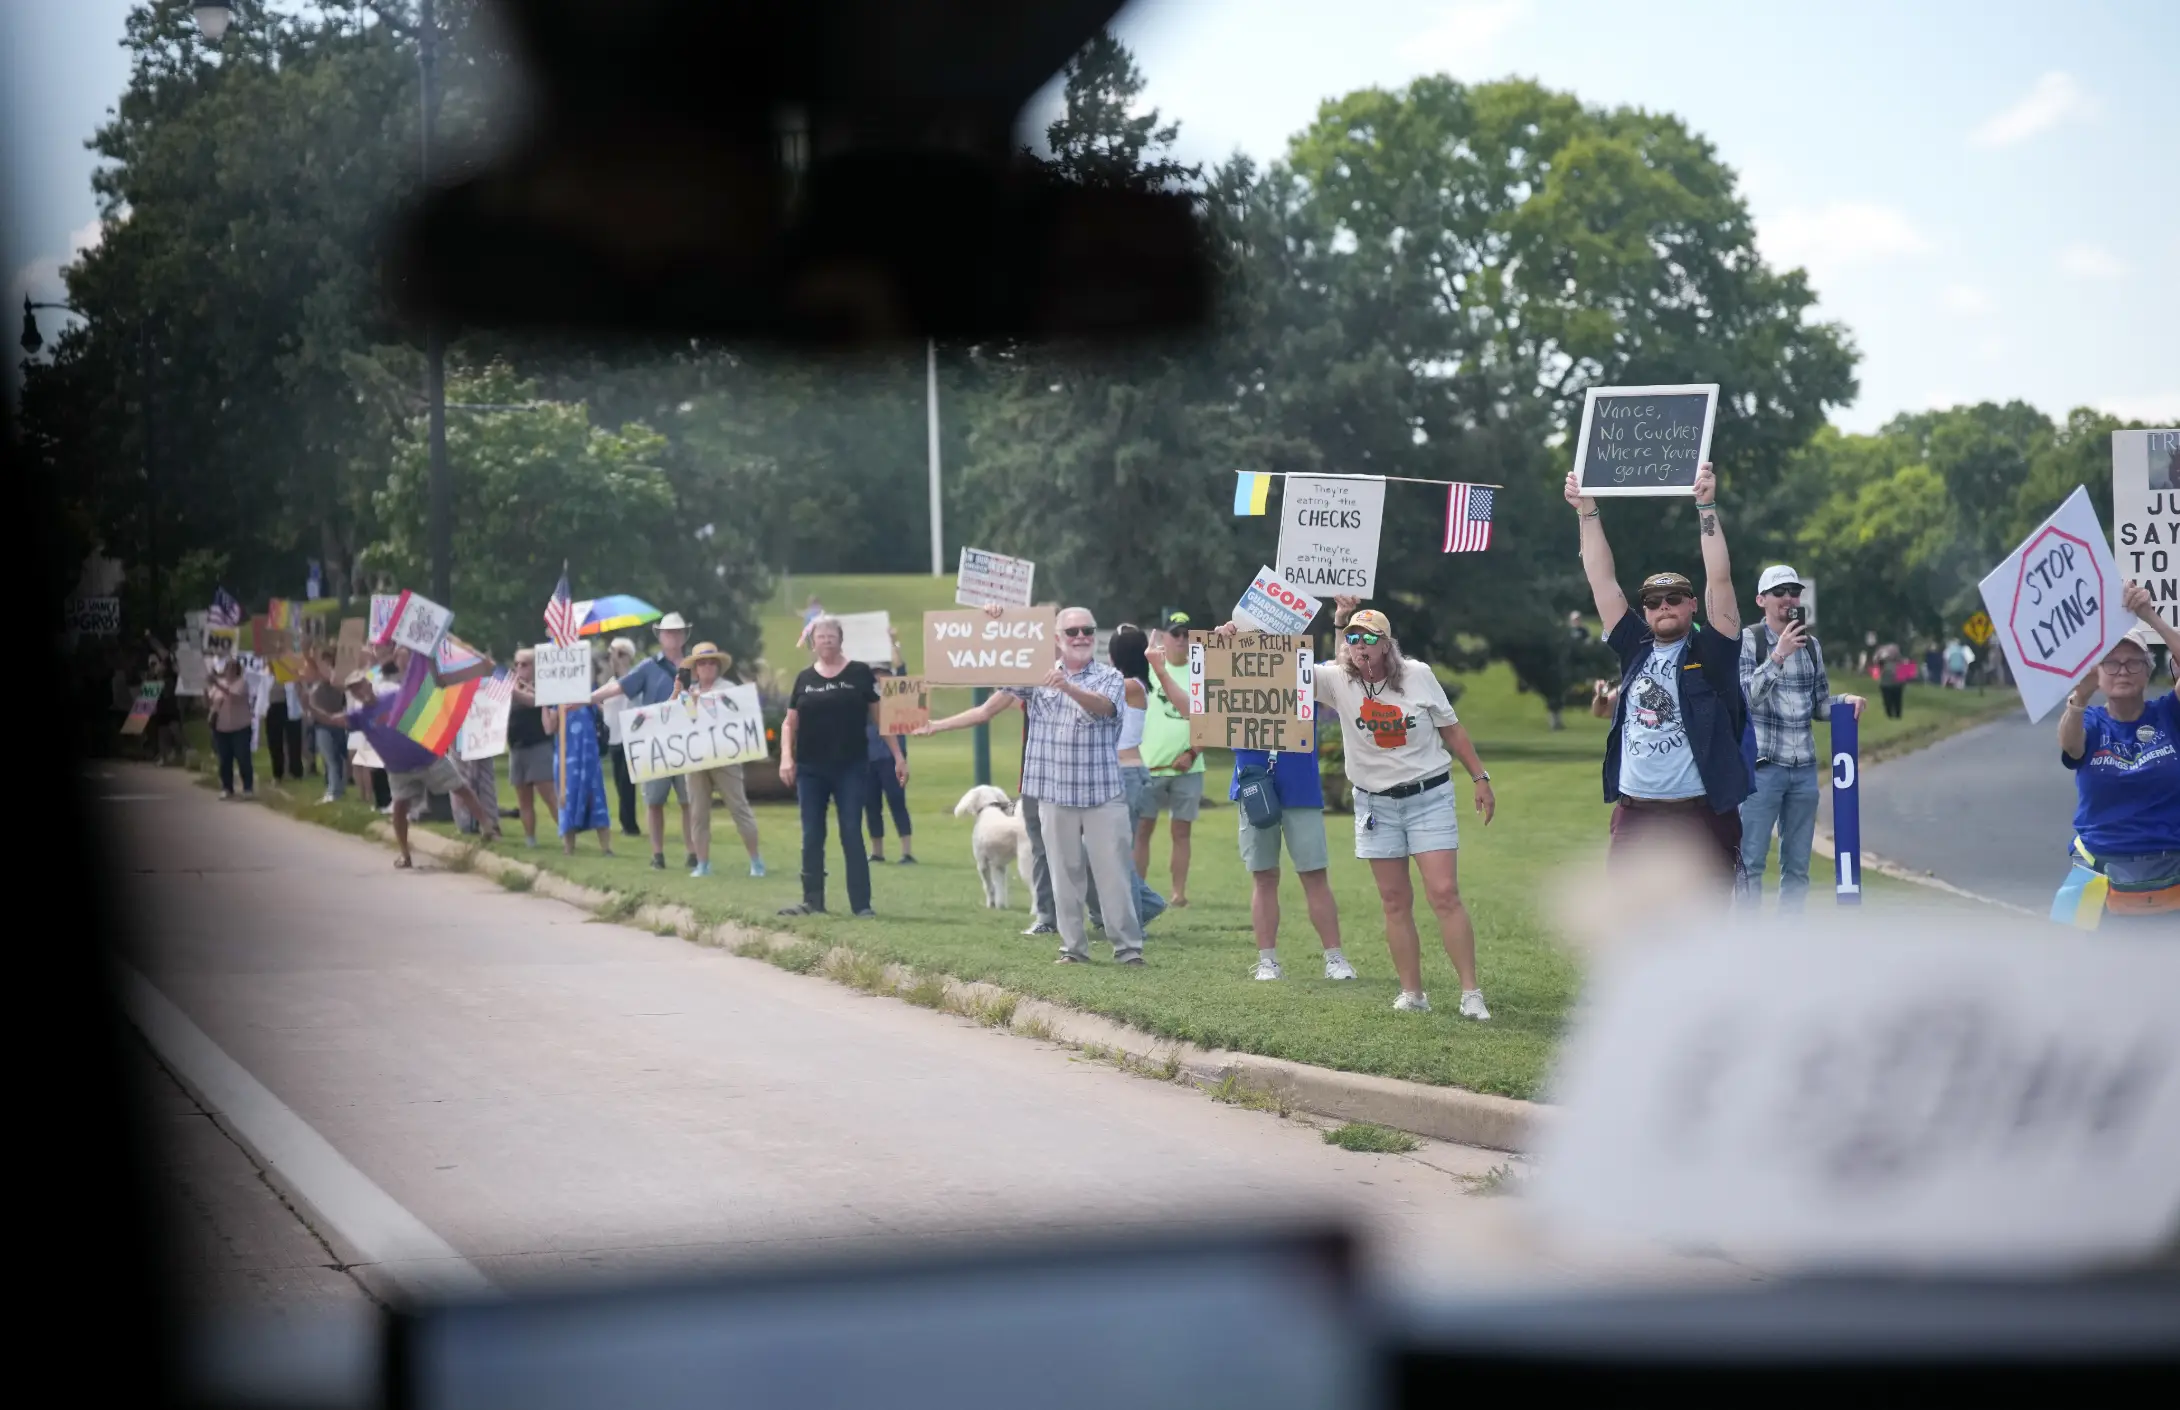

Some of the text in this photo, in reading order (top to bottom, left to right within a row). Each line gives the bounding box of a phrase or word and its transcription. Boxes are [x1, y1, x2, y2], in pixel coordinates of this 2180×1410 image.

[1597, 399, 1661, 419] Vance,
[1600, 421, 1699, 441] No Couches
[1597, 443, 1653, 461] Where
[2147, 433, 2180, 451] TR
[1313, 484, 1349, 498] They're
[1296, 498, 1356, 507] eating the
[1297, 509, 1361, 529] CHECKS
[2121, 523, 2180, 545] SAY
[1312, 543, 1351, 555] They're
[1297, 554, 1358, 566] eating the
[2130, 550, 2169, 573] TO
[1285, 566, 1367, 587] BALANCES
[2026, 543, 2074, 605] STOP
[1267, 582, 1307, 611] GOP
[2121, 579, 2178, 601] AN
[1247, 591, 1294, 625] GUARDIANS
[2031, 578, 2100, 659] LYING
[933, 620, 1044, 641] YOU SUCK
[208, 635, 232, 649] NO
[1207, 632, 1292, 652] EAT THE RICH
[537, 648, 585, 666] FASCIST
[946, 648, 1035, 668] VANCE
[1231, 652, 1285, 678] KEEP
[538, 665, 586, 680] CORRUPT
[882, 680, 922, 698] MONE
[1204, 679, 1298, 715] FREEDOM
[1355, 715, 1417, 731] COOKE
[1226, 717, 1287, 751] FREE
[628, 717, 761, 776] FASCISM
[2090, 756, 2102, 766] NO
[2103, 755, 2129, 771] KINGS
[2138, 744, 2177, 767] AMERICA
